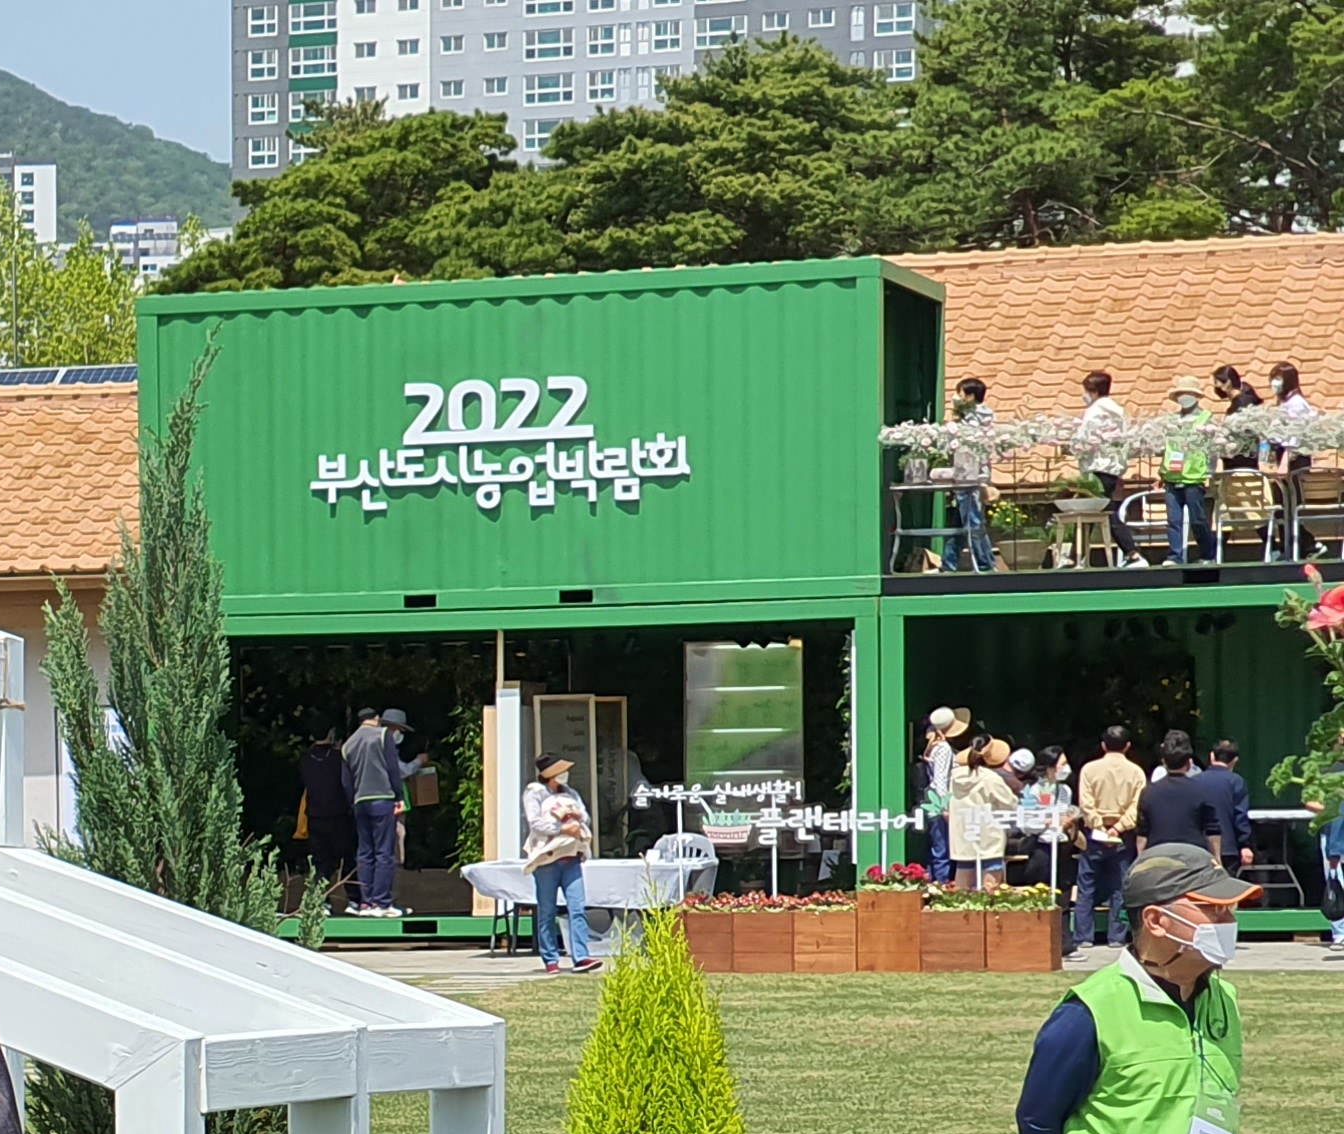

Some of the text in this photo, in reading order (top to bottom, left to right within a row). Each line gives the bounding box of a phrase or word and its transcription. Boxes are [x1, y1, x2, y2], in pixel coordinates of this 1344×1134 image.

[403, 376, 594, 446] 2022
[310, 432, 691, 511] 부산도시농업박람회
[633, 783, 702, 807] 슬기로운
[755, 805, 924, 845] 플랜테리어
